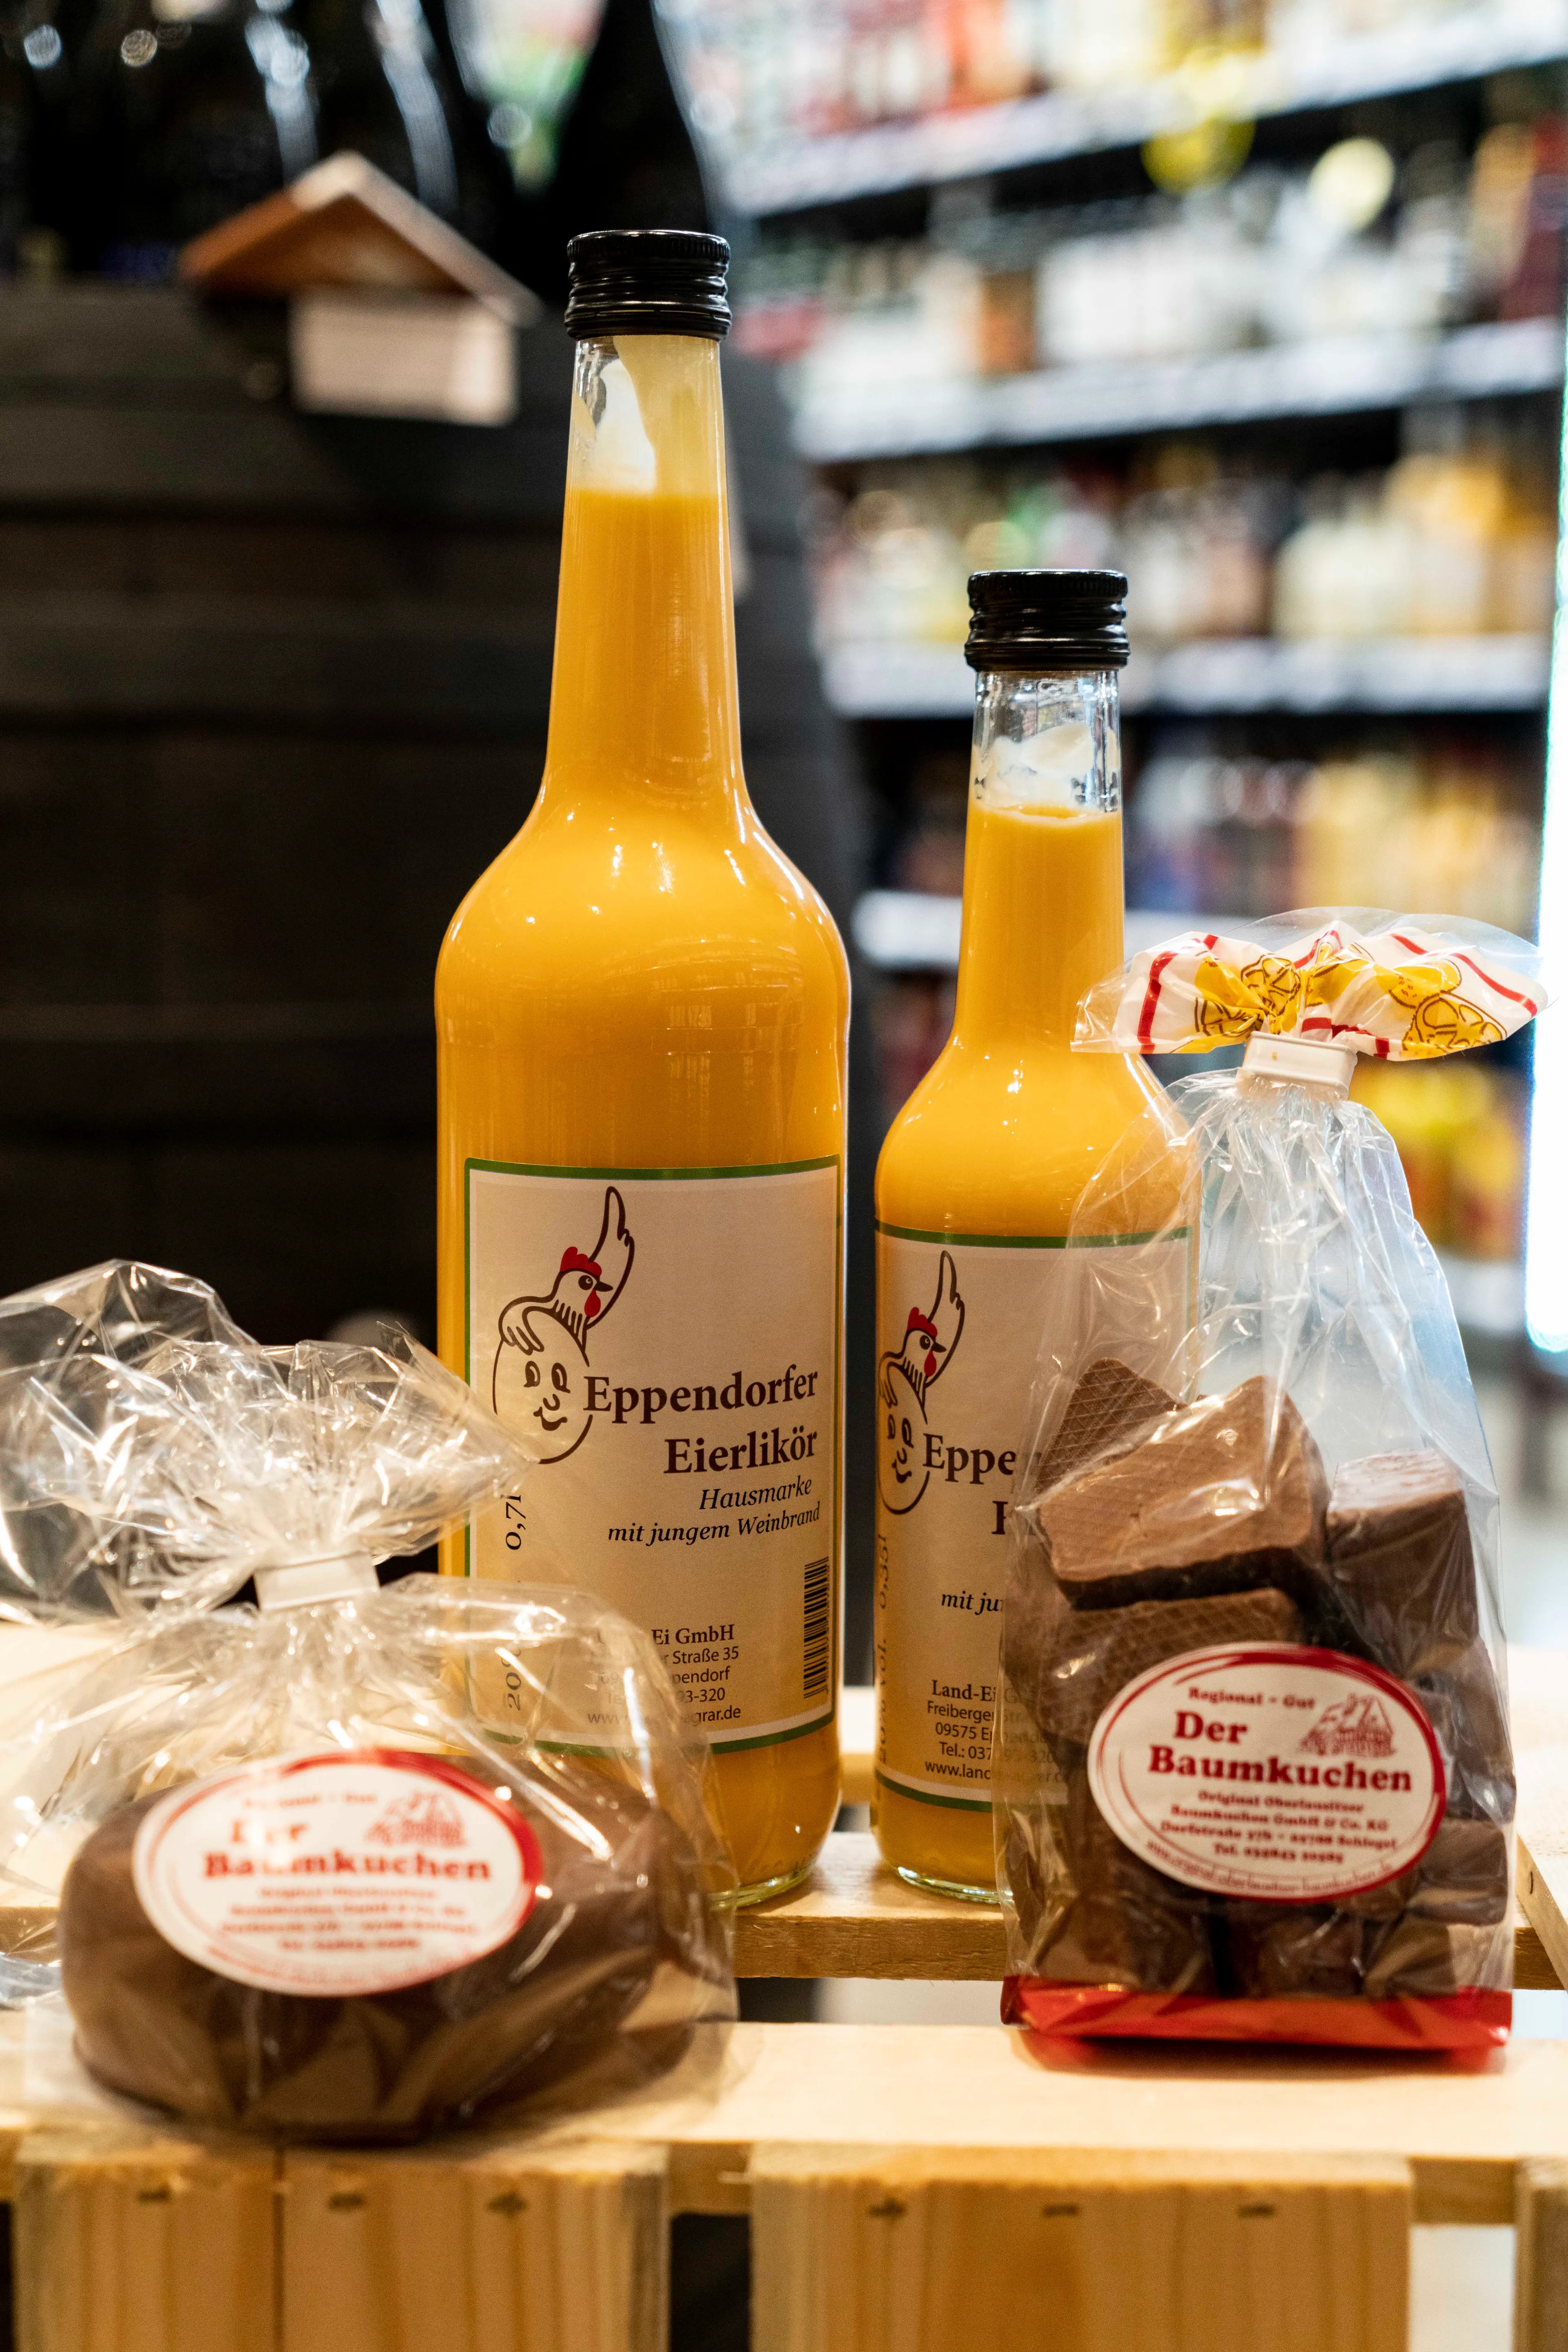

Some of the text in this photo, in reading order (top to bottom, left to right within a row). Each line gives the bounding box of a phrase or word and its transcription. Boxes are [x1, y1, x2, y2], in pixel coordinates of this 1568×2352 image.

[583, 1363, 818, 1424] Eppendorfer
[664, 1425, 817, 1474] Eierlikör
[699, 1475, 812, 1510] Hausmarke
[608, 1501, 820, 1546] mit jungem Weinbrand
[941, 1590, 974, 1611] mit
[675, 1624, 735, 1644] GmbH
[673, 1648, 719, 1665] Straße
[723, 1646, 739, 1660] 35
[931, 1679, 996, 1703] Land-Ei
[1188, 1686, 1263, 1705] Regional
[1283, 1694, 1315, 1709] Gut
[935, 1722, 977, 1740] 09575
[1174, 1710, 1248, 1744] Der
[939, 1742, 964, 1758] Tel.:
[1148, 1744, 1412, 1792] Baumkuchen
[1198, 1790, 1259, 1806] Original
[1171, 1803, 1268, 1822] Baumkuchen
[1273, 1813, 1319, 1827] GmbH
[1366, 1819, 1388, 1831] KG
